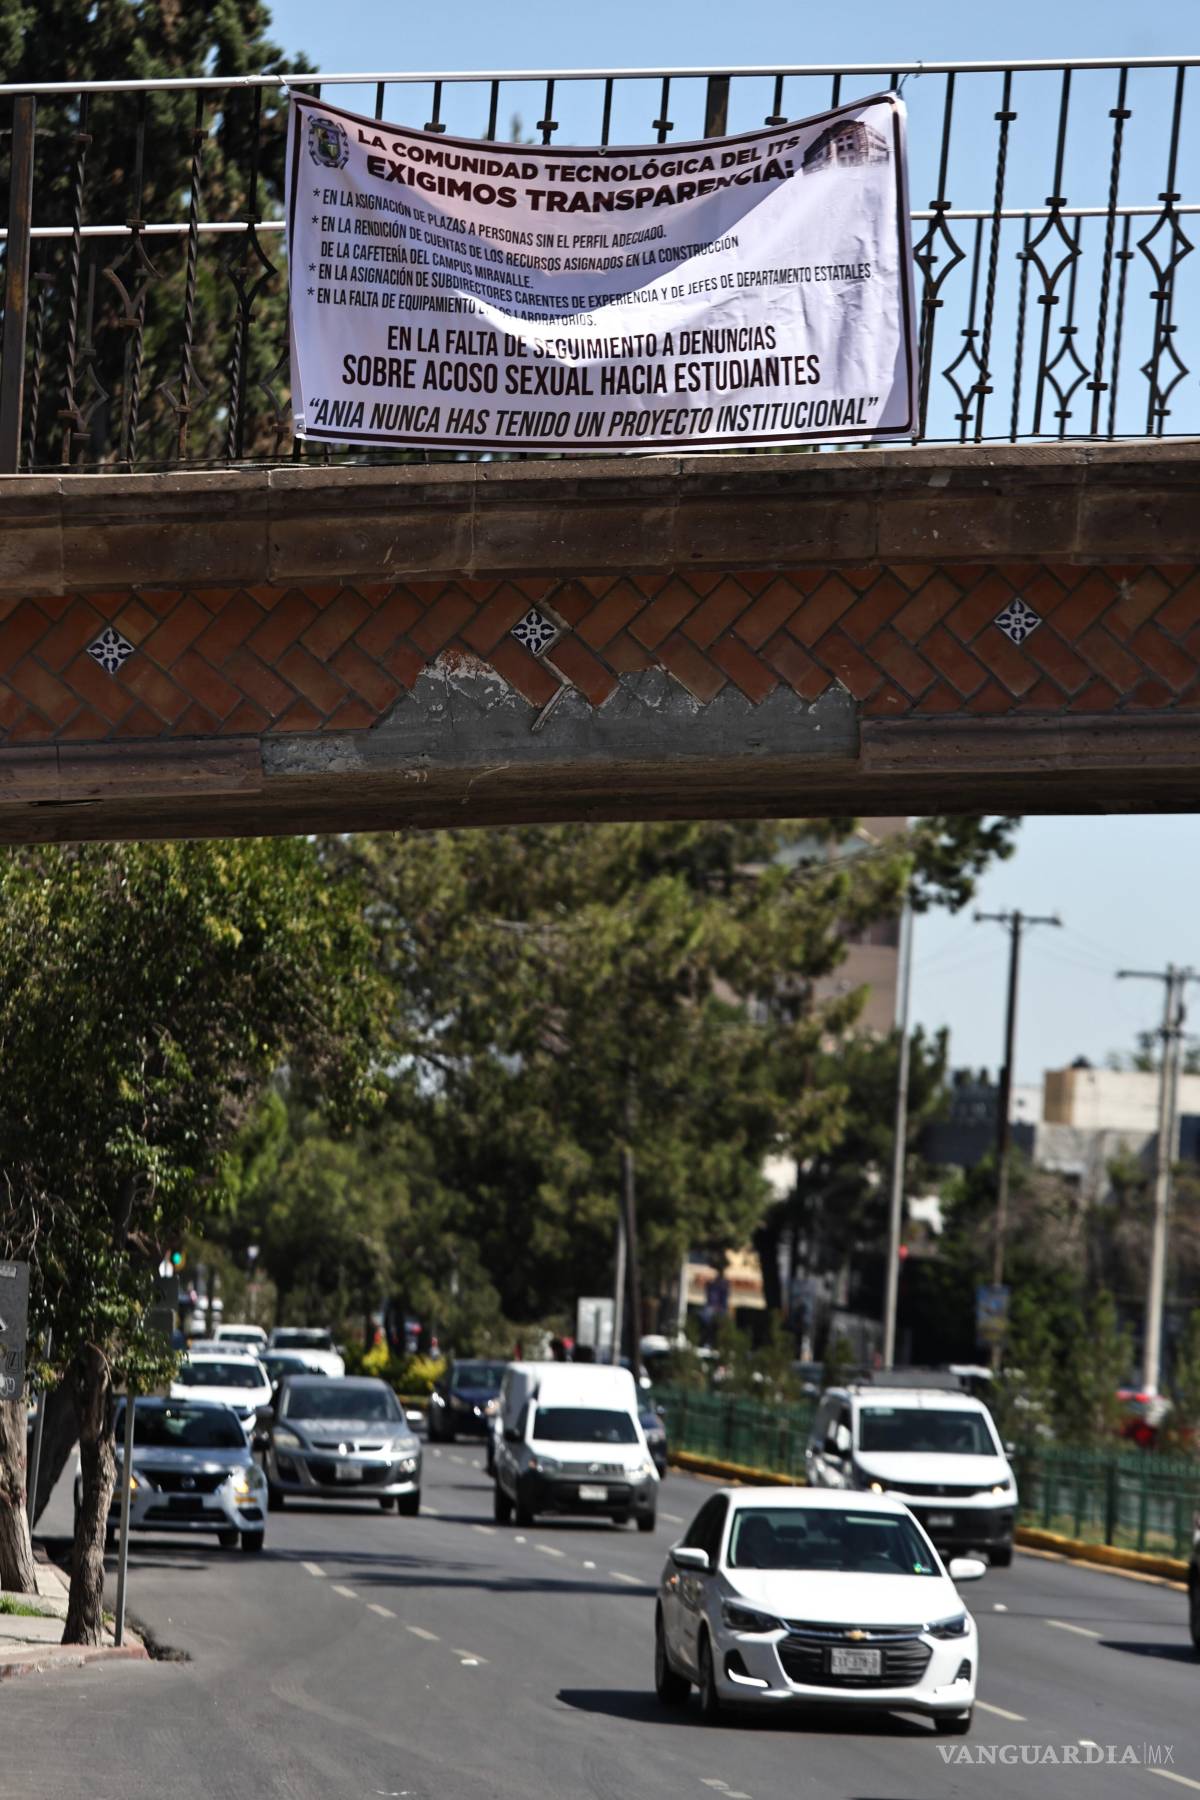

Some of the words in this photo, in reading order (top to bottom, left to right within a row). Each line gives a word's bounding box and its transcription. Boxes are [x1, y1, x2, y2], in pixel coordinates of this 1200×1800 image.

[358, 129, 386, 151] LA
[392, 143, 538, 180] COMUNIDAD
[545, 156, 715, 183] TECNOLÓGICA
[721, 147, 762, 168] DEL
[767, 136, 800, 157] ITS
[367, 155, 517, 208] EXIGIMOS
[525, 158, 794, 213] TRANSPARENCIA:
[323, 189, 338, 206] EN
[340, 190, 354, 207] LA
[355, 193, 411, 218] ASIGNACIÓN
[413, 208, 426, 223] DE
[427, 213, 466, 234] PLAZAS
[468, 222, 476, 236] A
[478, 224, 533, 246] PERSONAS
[536, 233, 554, 248] SIN
[557, 234, 570, 249] EL
[573, 235, 609, 249] PERFIL
[612, 224, 667, 248] ADECUADO.
[321, 216, 335, 232] EN
[338, 217, 351, 234] LA
[354, 219, 406, 239] RENDICIÓN
[409, 226, 422, 242] DE
[424, 231, 467, 256] CUENTAS
[469, 245, 482, 259] DE
[484, 248, 503, 264] LOS
[506, 252, 561, 271] RECURSOS
[563, 256, 623, 271] ASIGNADOS
[625, 253, 640, 267] EN
[642, 250, 656, 265] LA
[659, 235, 739, 263] CONSTRUCCIÓN
[321, 241, 334, 258] DE
[336, 242, 350, 259] LA
[352, 243, 408, 264] CAFETERÍA
[410, 248, 430, 265] DEL
[432, 252, 473, 276] CAMPUS
[475, 265, 534, 289] MIRAVALLE.
[317, 287, 331, 304] EN
[334, 289, 347, 305] LA
[350, 289, 379, 308] FALTA
[382, 293, 397, 309] DE
[398, 294, 476, 314] EQUIPAMIENTO
[318, 263, 332, 280] EN
[335, 265, 348, 281] LA
[350, 266, 414, 287] ASIGNACIÓN
[415, 271, 429, 287] DE
[431, 272, 512, 303] SUBDIRECTORES
[514, 291, 569, 308] CARENTES
[572, 296, 586, 309] DE
[588, 289, 658, 308] EXPERIENCIA
[660, 287, 668, 300] Y
[671, 285, 684, 298] DE
[688, 277, 718, 296] JEFES
[720, 274, 735, 288] DE
[738, 267, 811, 288] DEPARTAMENTO
[815, 263, 872, 282] ESTATALES
[388, 326, 411, 352] EN
[417, 328, 440, 354] LA
[445, 330, 498, 356] FALTA
[504, 333, 527, 357] DE
[533, 334, 657, 360] SEGUIMIENTO
[663, 332, 675, 357] A
[679, 326, 776, 355] DENUNCIAS
[342, 355, 417, 389] SOBRE
[423, 360, 498, 394] ACOSO
[505, 365, 594, 396] SEXUAL
[600, 363, 668, 395] HACIA
[675, 355, 821, 393] ESTUDIANTES
[308, 398, 363, 430] “ANIA
[369, 403, 440, 434] NUNCA
[445, 408, 490, 435] HAS
[495, 410, 570, 437] TENIDO
[574, 411, 605, 437] UN
[608, 407, 713, 437] PROYECTO
[716, 397, 879, 432] INSTITUCIONAL”
